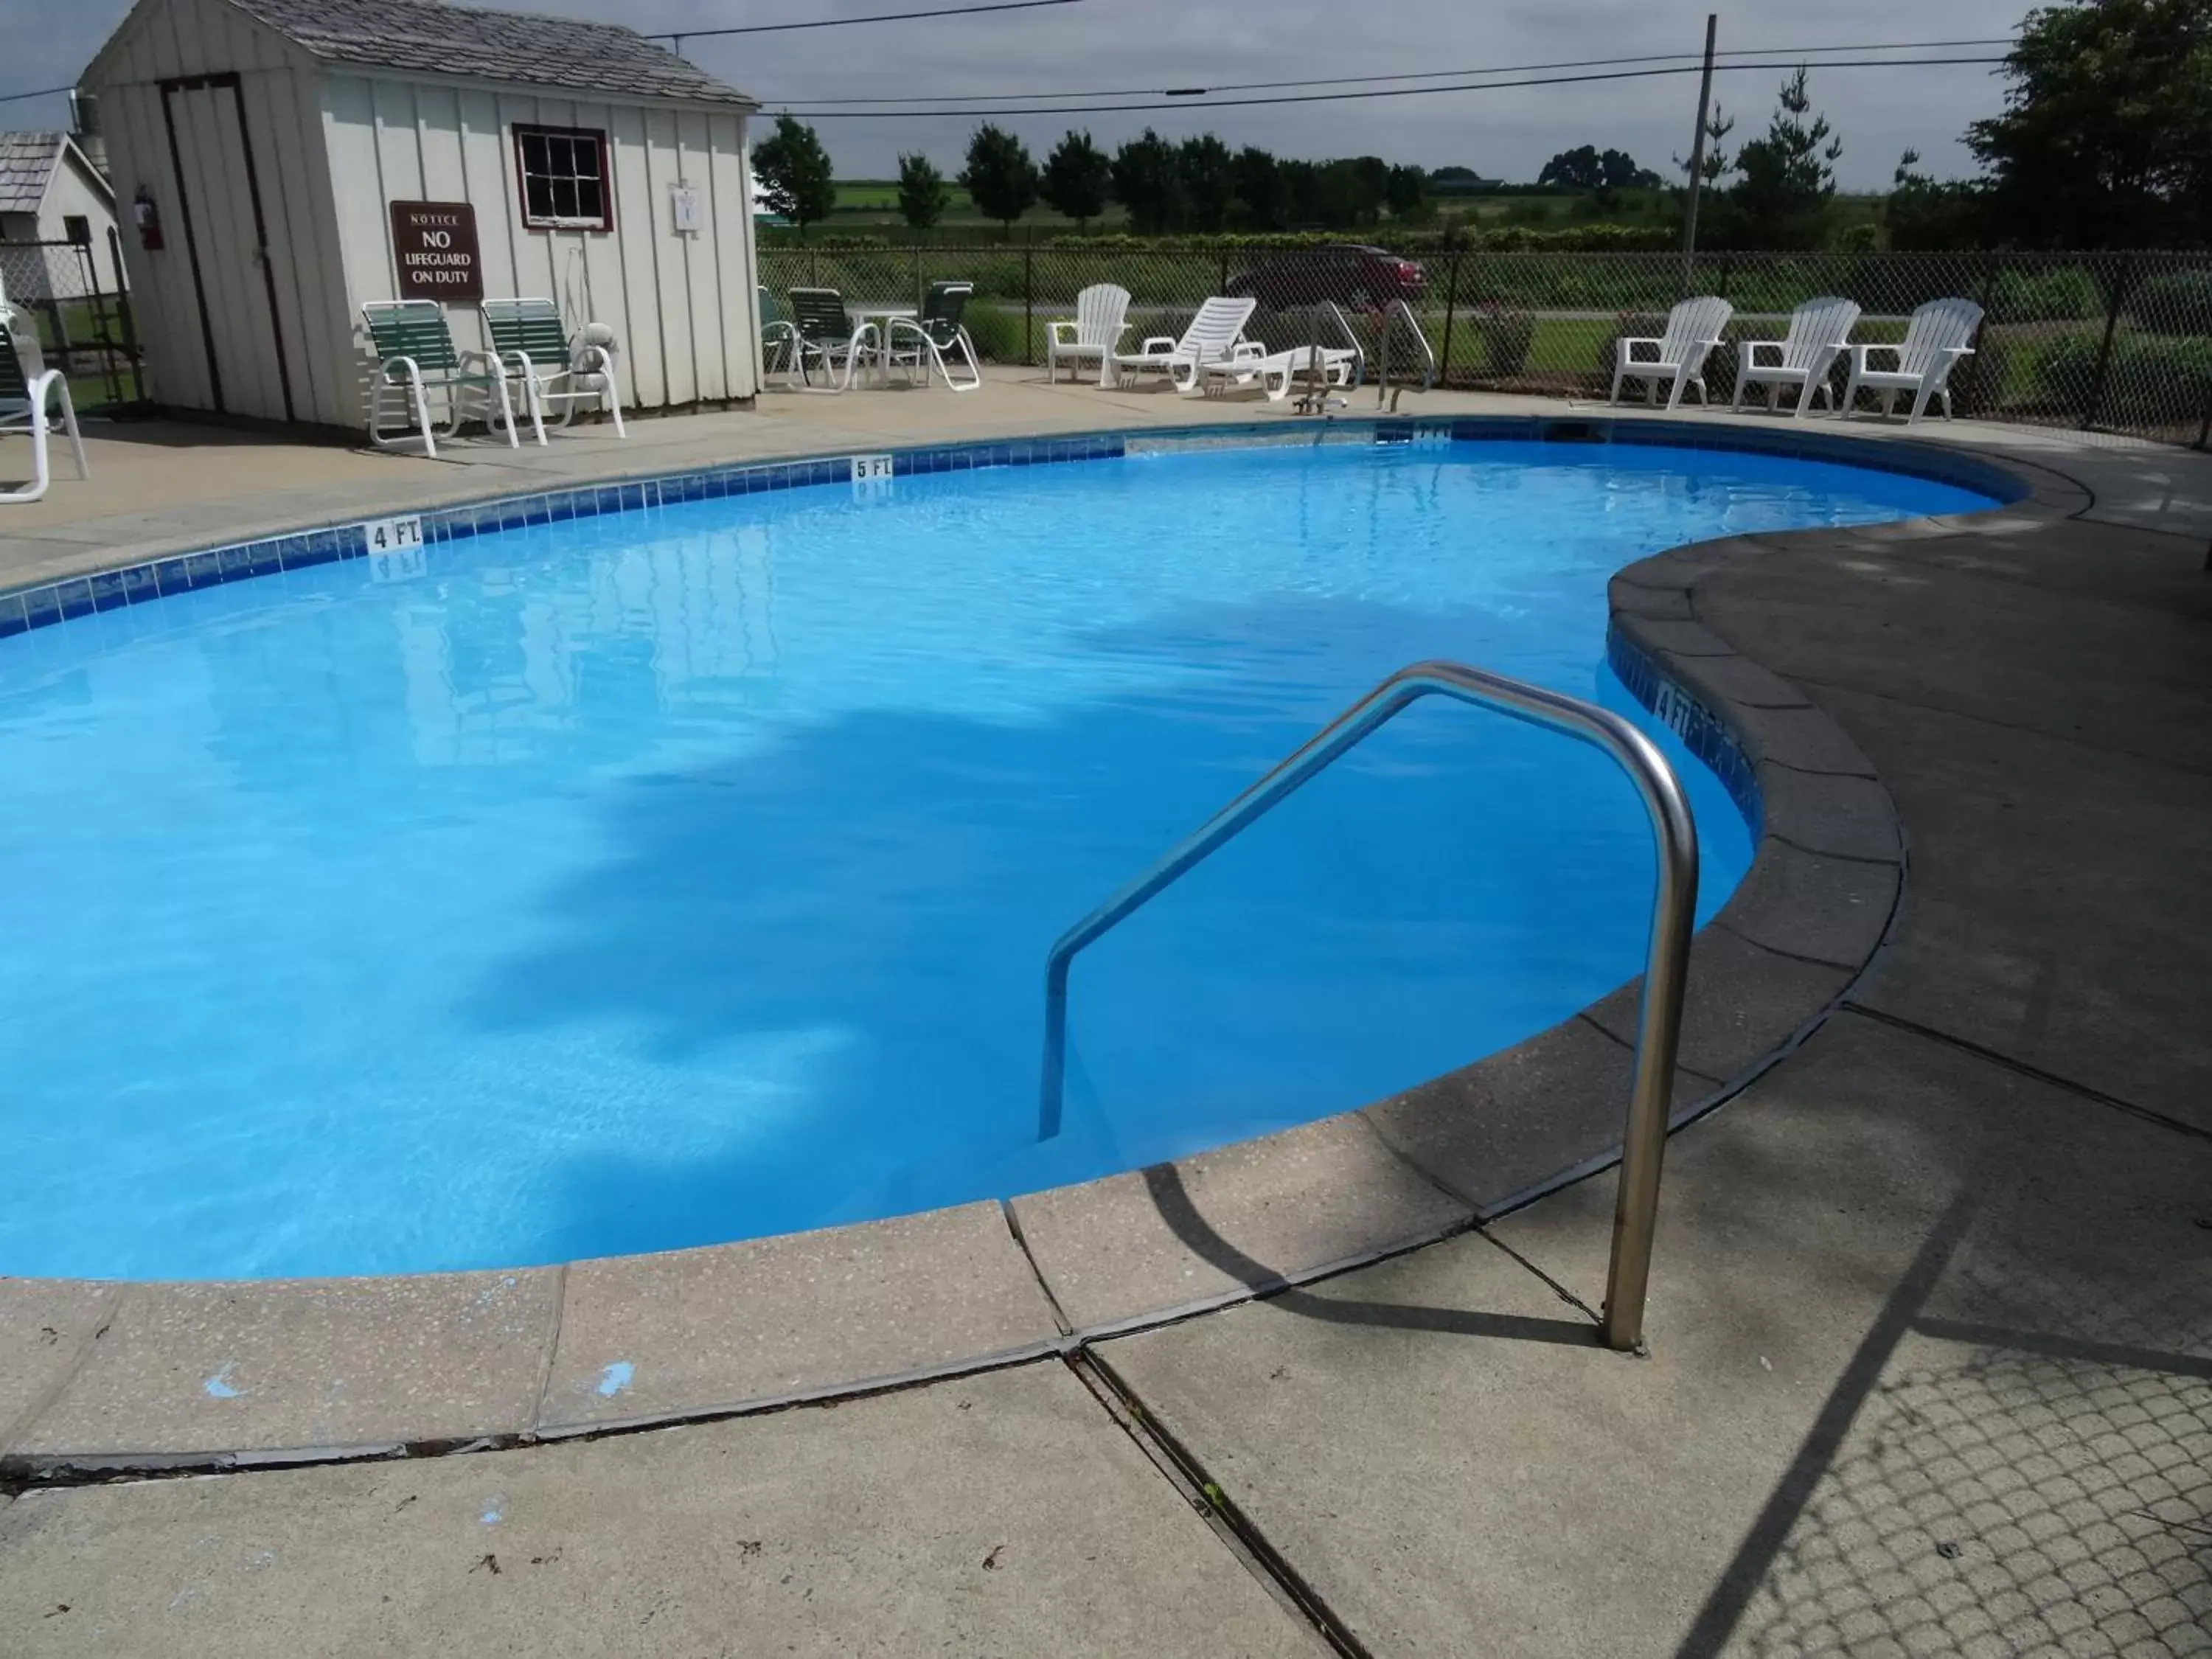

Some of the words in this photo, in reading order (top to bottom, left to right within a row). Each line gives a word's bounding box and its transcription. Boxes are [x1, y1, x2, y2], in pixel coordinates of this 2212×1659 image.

[410, 213, 459, 225] NOTICE
[422, 231, 451, 248] NO
[406, 253, 471, 266] LIFEGUARD
[412, 270, 433, 283] ON
[436, 271, 469, 283] DUTY
[858, 460, 867, 479] 5
[375, 526, 387, 548] 4
